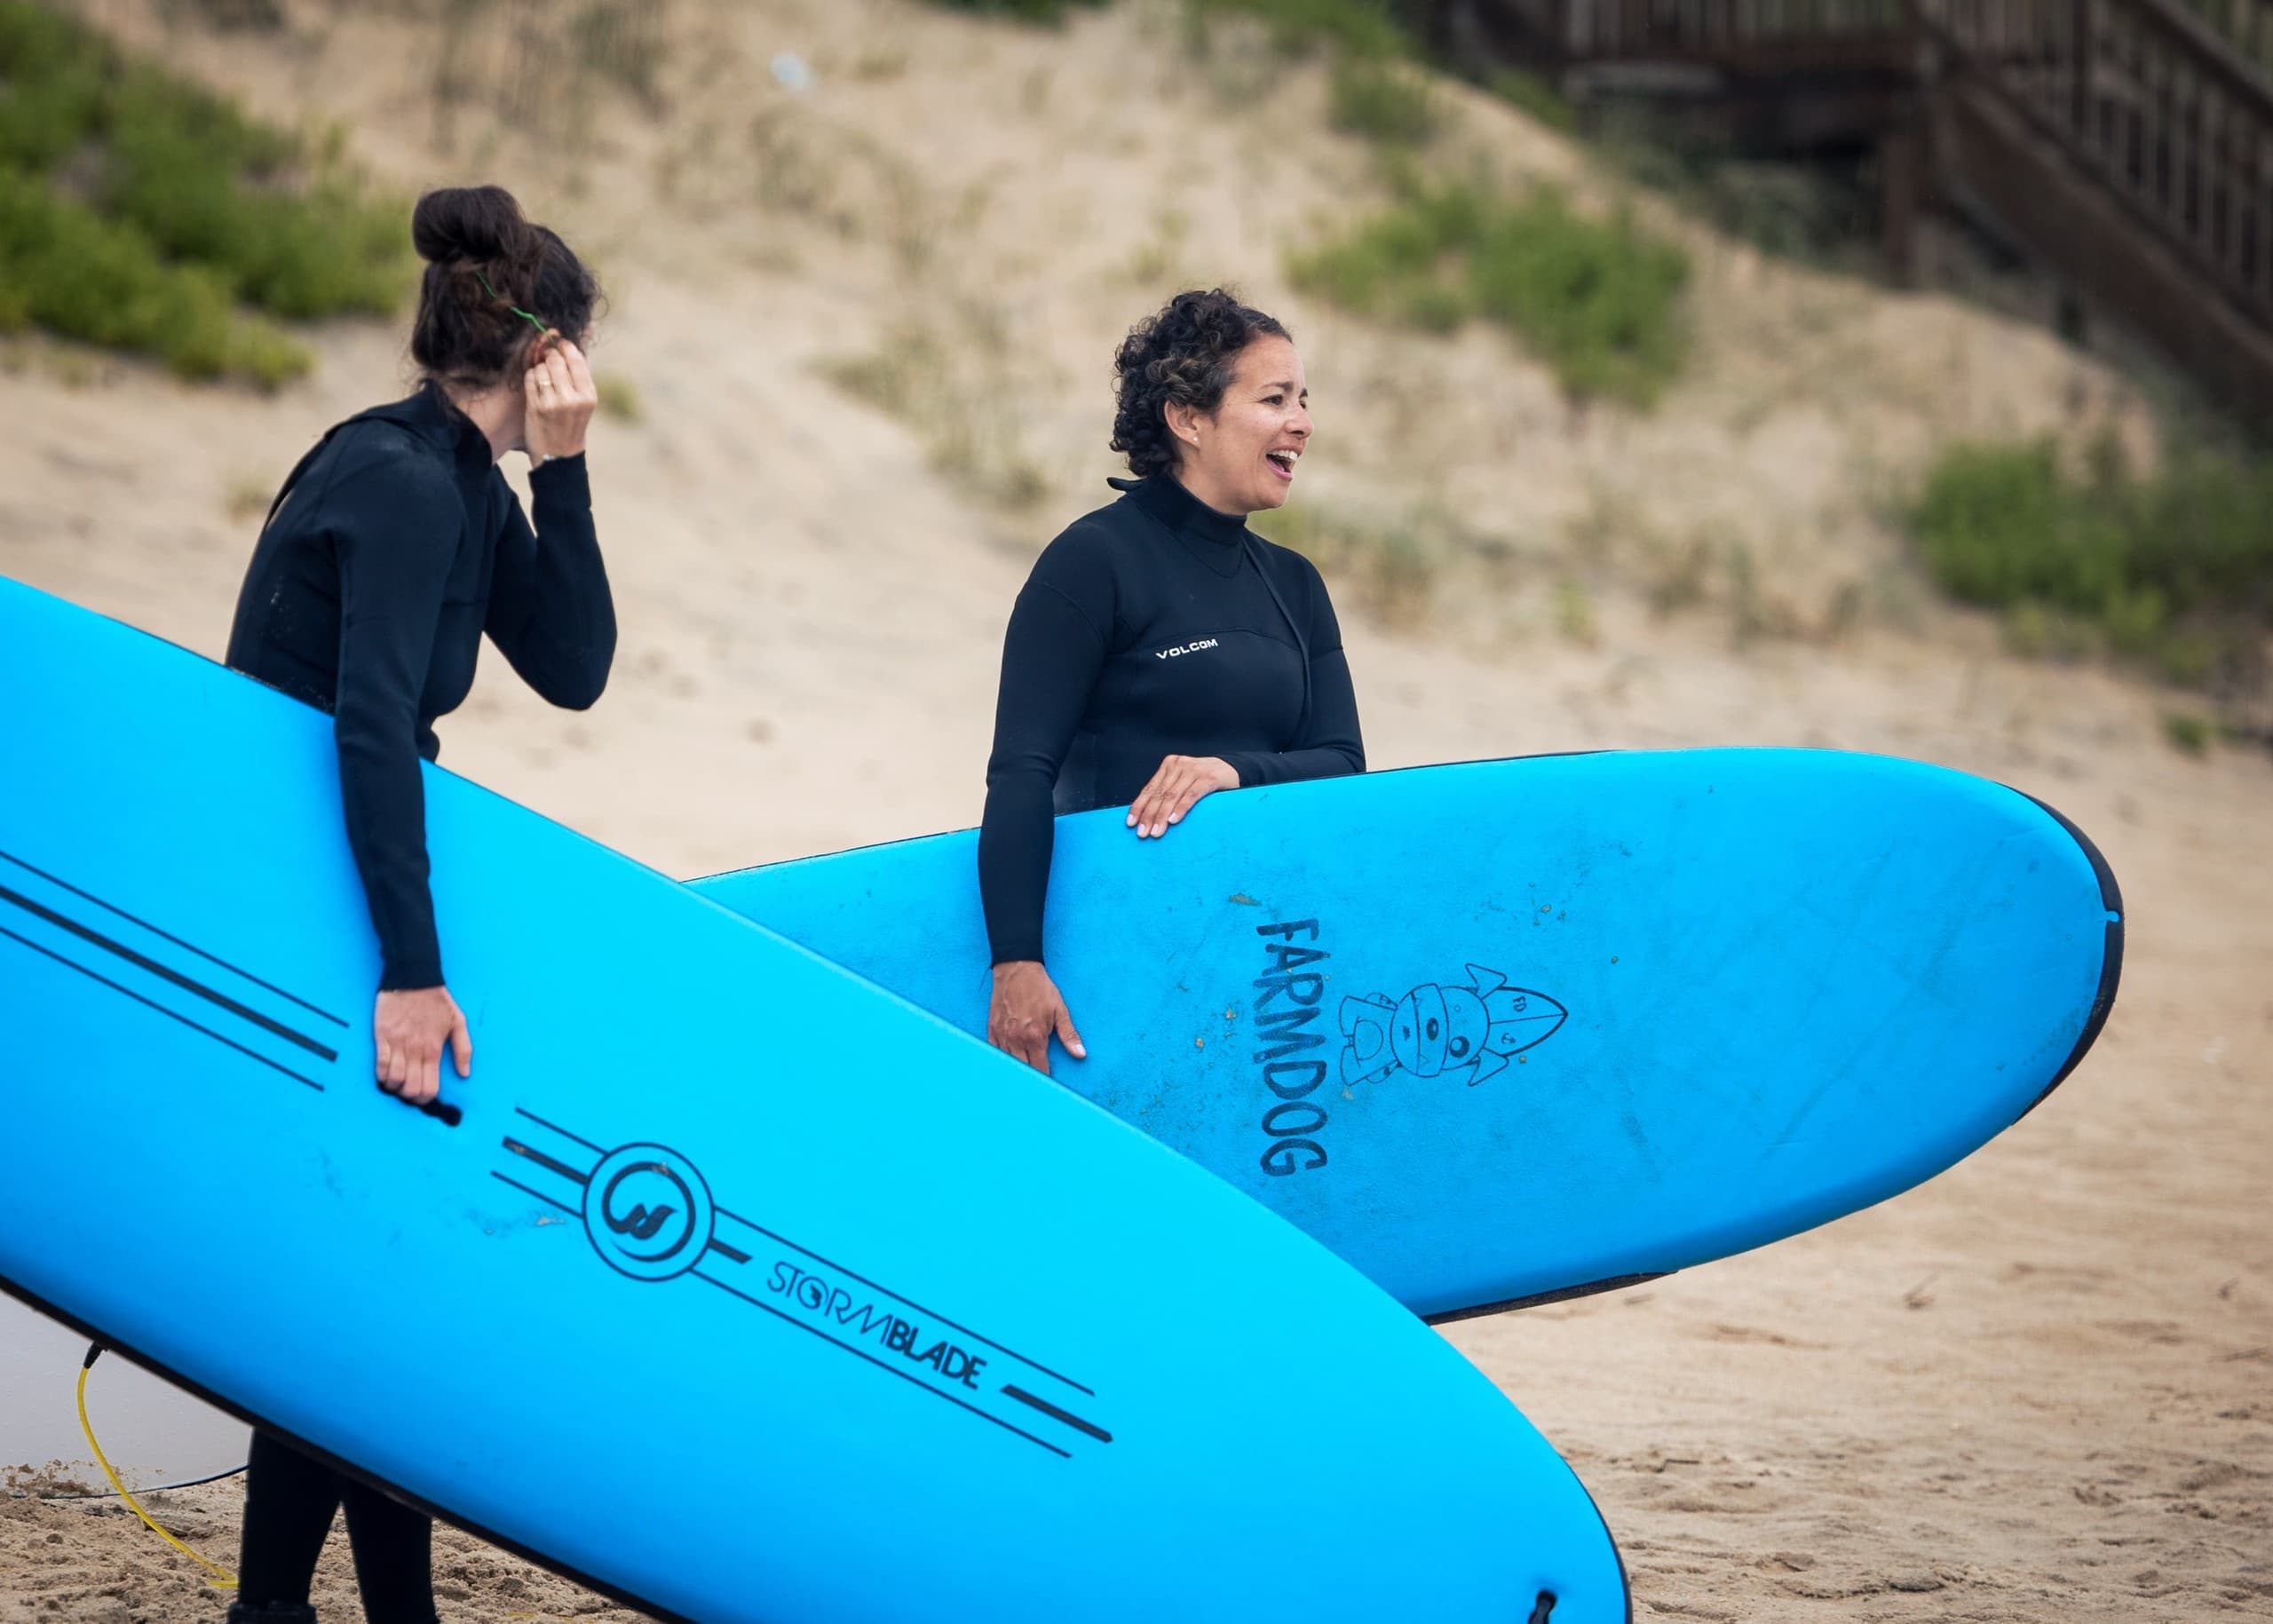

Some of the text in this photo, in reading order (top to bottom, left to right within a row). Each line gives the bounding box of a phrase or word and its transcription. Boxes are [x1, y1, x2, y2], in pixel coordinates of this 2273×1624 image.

[1156, 638, 1218, 659] VOLCOM
[1512, 996, 1527, 1011] FD
[1255, 919, 1328, 1176] FARMDOG
[768, 1261, 986, 1390] STORMBLADE
